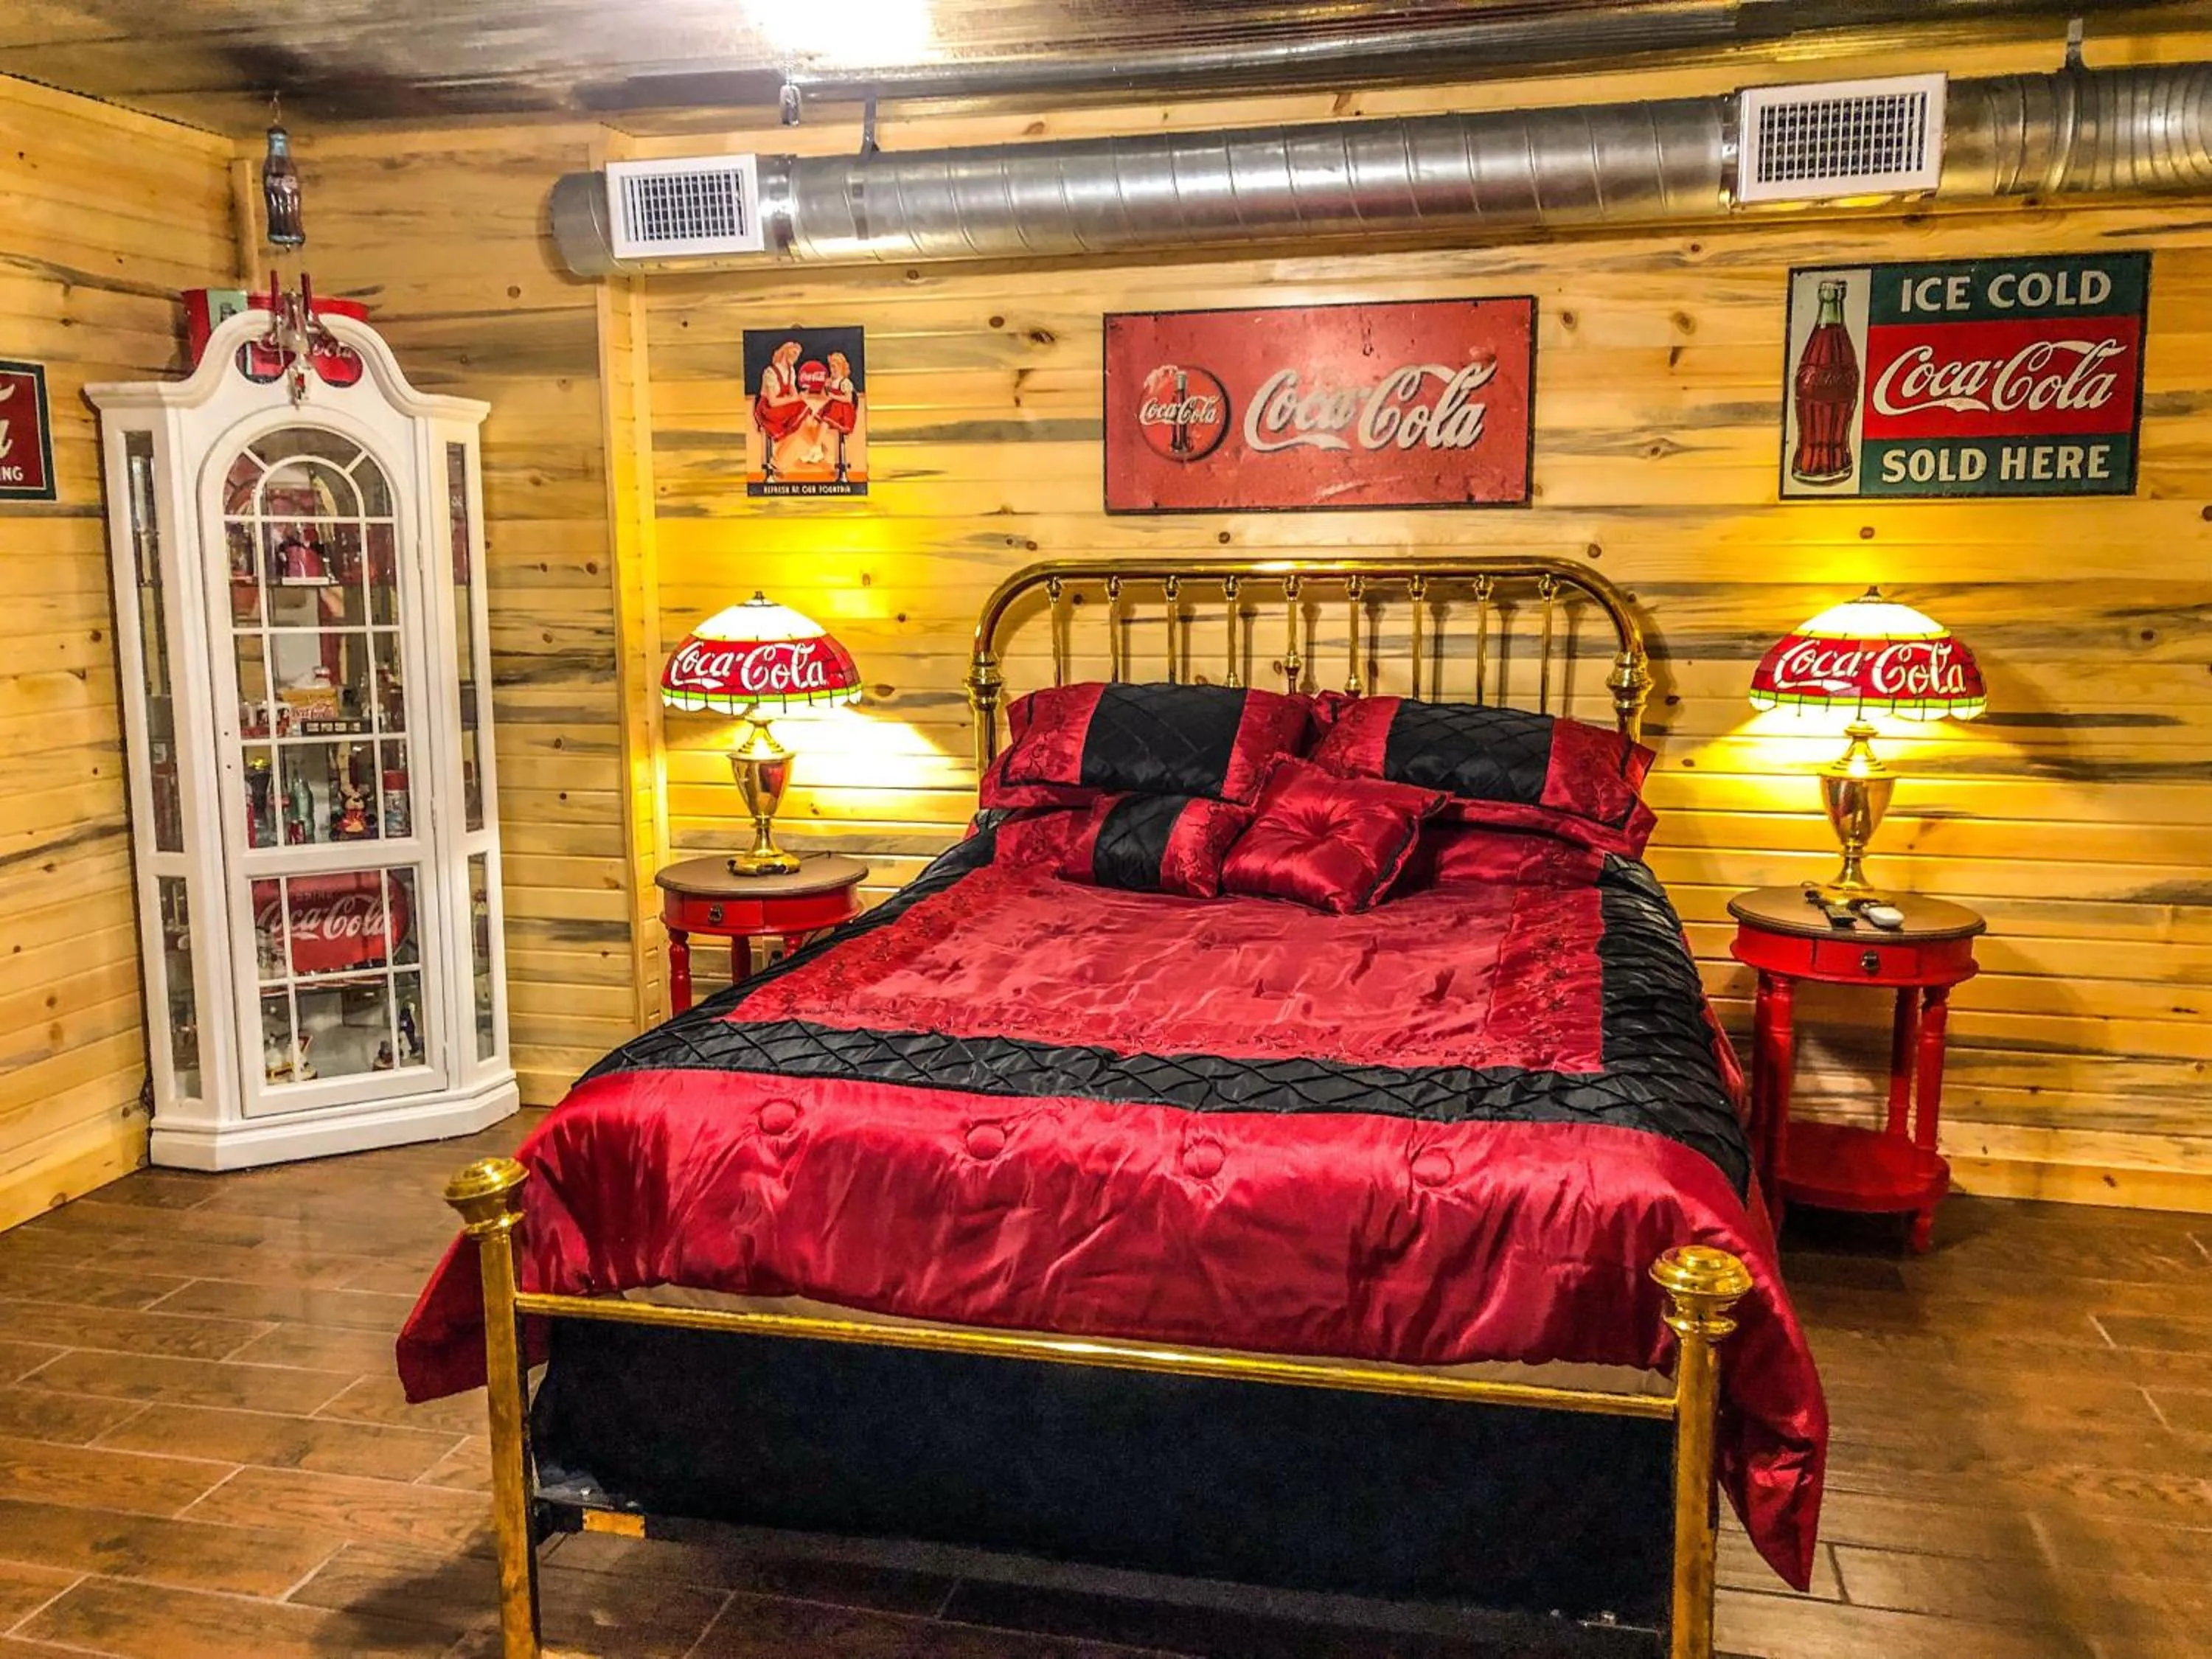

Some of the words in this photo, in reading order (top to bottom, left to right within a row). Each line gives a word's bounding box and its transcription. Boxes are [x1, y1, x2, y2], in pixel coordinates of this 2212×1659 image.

[1899, 276, 1972, 313] ICE
[1987, 270, 2112, 309] COLD
[1872, 338, 2127, 417] Coca-Cola
[1244, 361, 1498, 452] Coca-Cola
[1881, 447, 1988, 484] SOLD
[2000, 444, 2111, 481] HERE
[670, 641, 827, 691] Coca-Cola
[1773, 640, 1967, 695] Coca-Cola
